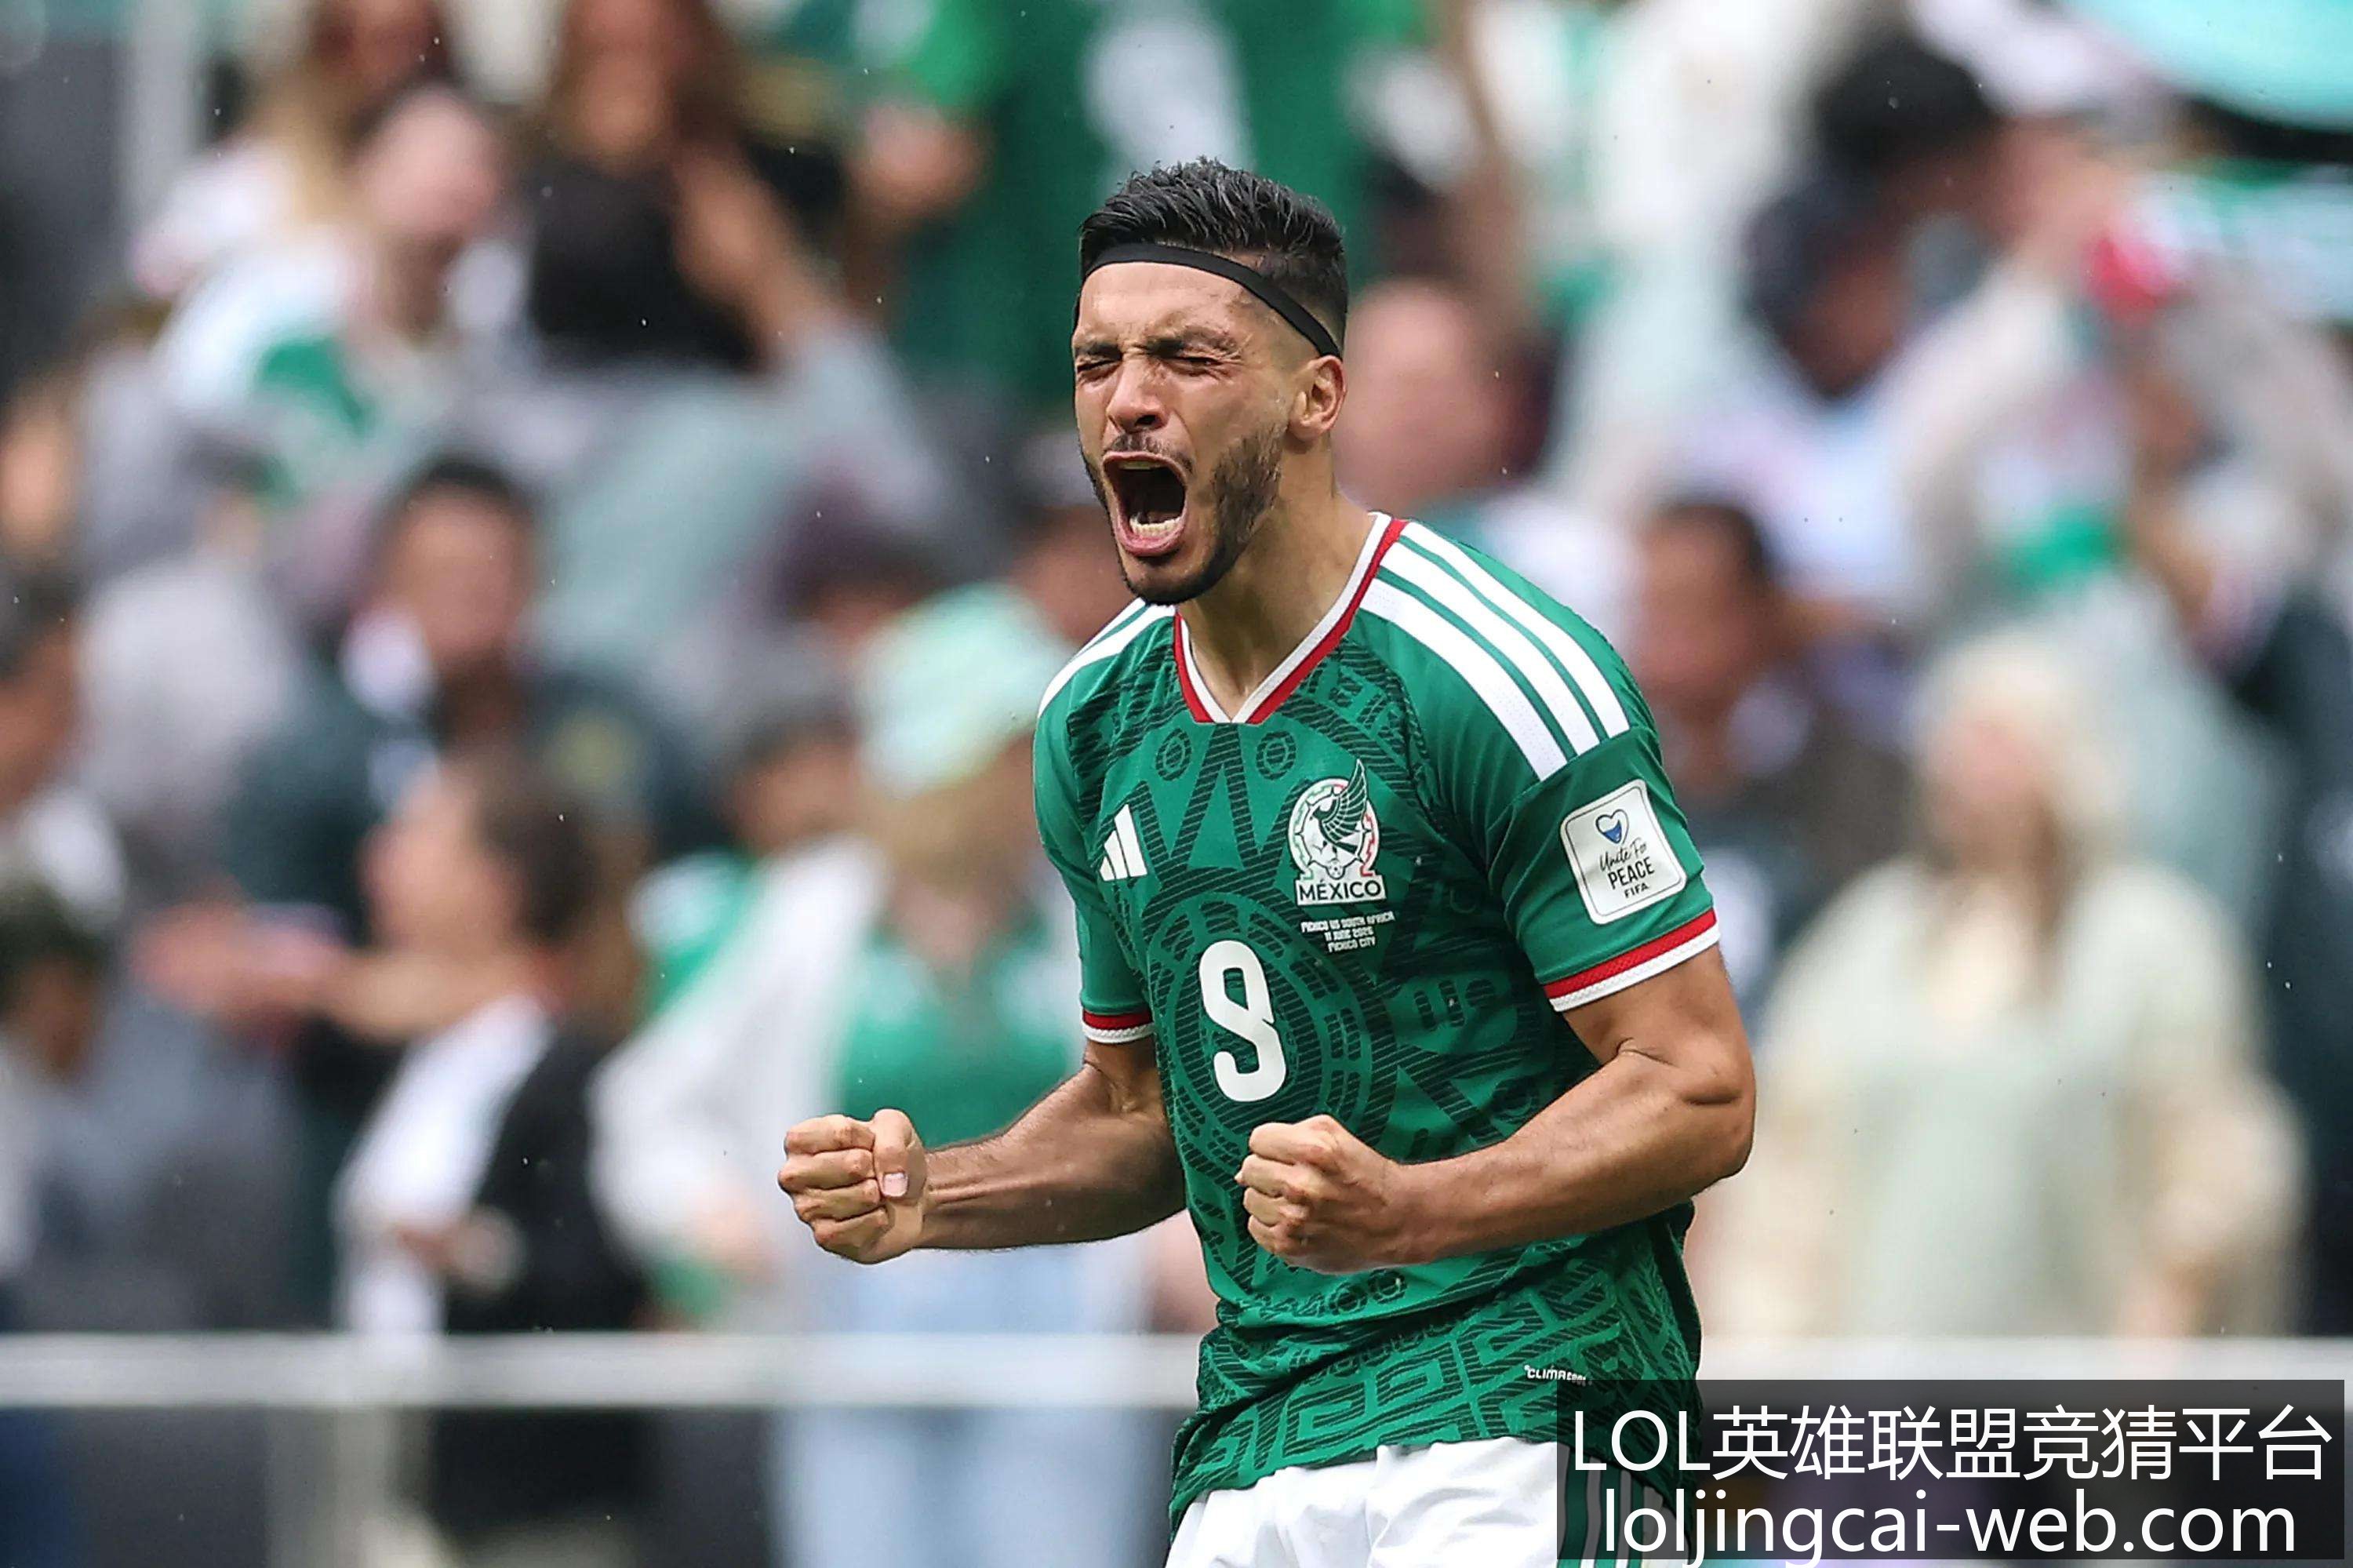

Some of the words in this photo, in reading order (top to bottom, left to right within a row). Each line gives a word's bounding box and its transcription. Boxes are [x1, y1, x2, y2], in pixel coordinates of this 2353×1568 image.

[1599, 846, 1632, 872] Unite
[1608, 857, 1655, 890] PEACE
[1299, 879, 1381, 901] MÉXICO
[1624, 882, 1649, 898] FIFA
[1199, 940, 1287, 1102] 9
